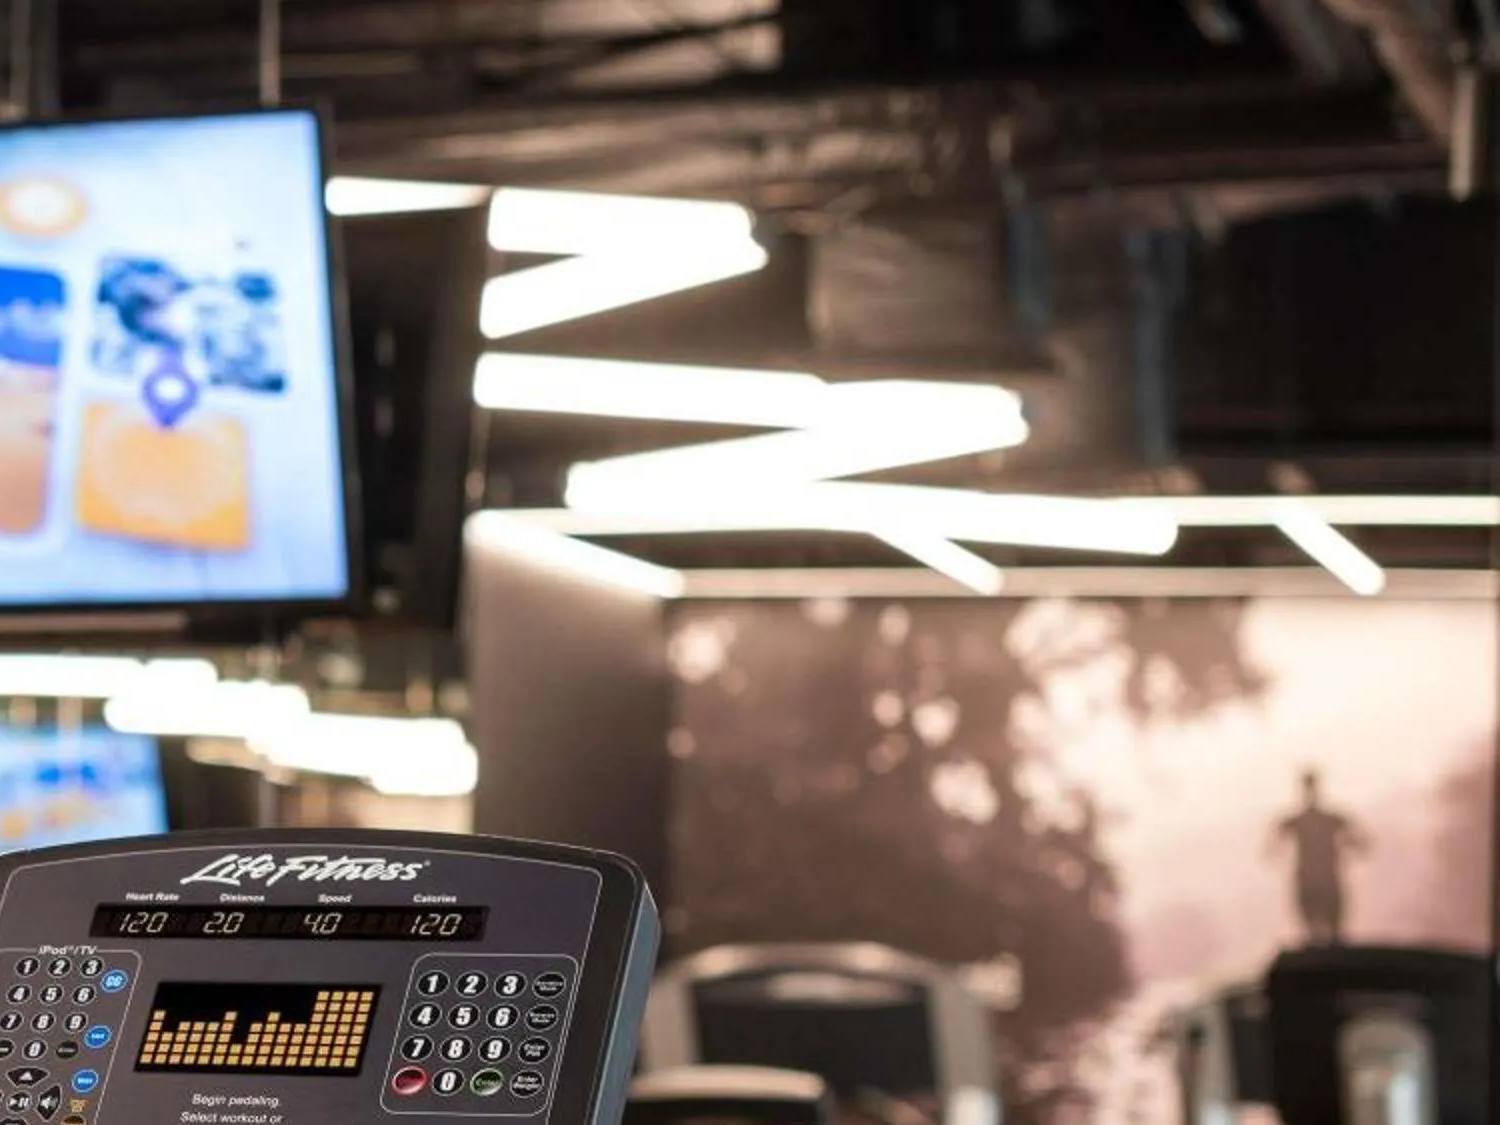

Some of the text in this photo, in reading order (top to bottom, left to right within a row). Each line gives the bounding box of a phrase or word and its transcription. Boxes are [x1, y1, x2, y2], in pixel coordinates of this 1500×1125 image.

[180, 854, 424, 887] Life Fitness
[126, 892, 179, 902] Heart Rate
[220, 893, 264, 902] Distance
[318, 894, 352, 904] Speed
[413, 894, 456, 903] Calories
[119, 912, 168, 933] 120
[203, 912, 244, 933] 2.0
[304, 913, 342, 934] 4.0
[411, 913, 461, 935] 120
[24, 960, 98, 975] 1 2 3
[428, 975, 438, 993] 1
[464, 975, 479, 994] 2
[503, 976, 518, 994] 3
[13, 987, 90, 1002] 4 5 6
[6, 1014, 82, 1030] 7 8 9
[417, 1006, 432, 1025] 4
[456, 1007, 471, 1026] 5
[495, 1008, 511, 1026] 6
[29, 1042, 41, 1057] 0
[412, 1039, 425, 1057] 7
[448, 1039, 464, 1058] 8
[487, 1040, 503, 1059] 9
[440, 1072, 456, 1091] 0
[192, 1093, 226, 1106] Begin
[181, 1112, 217, 1122] Select
[220, 1114, 267, 1123] workout
